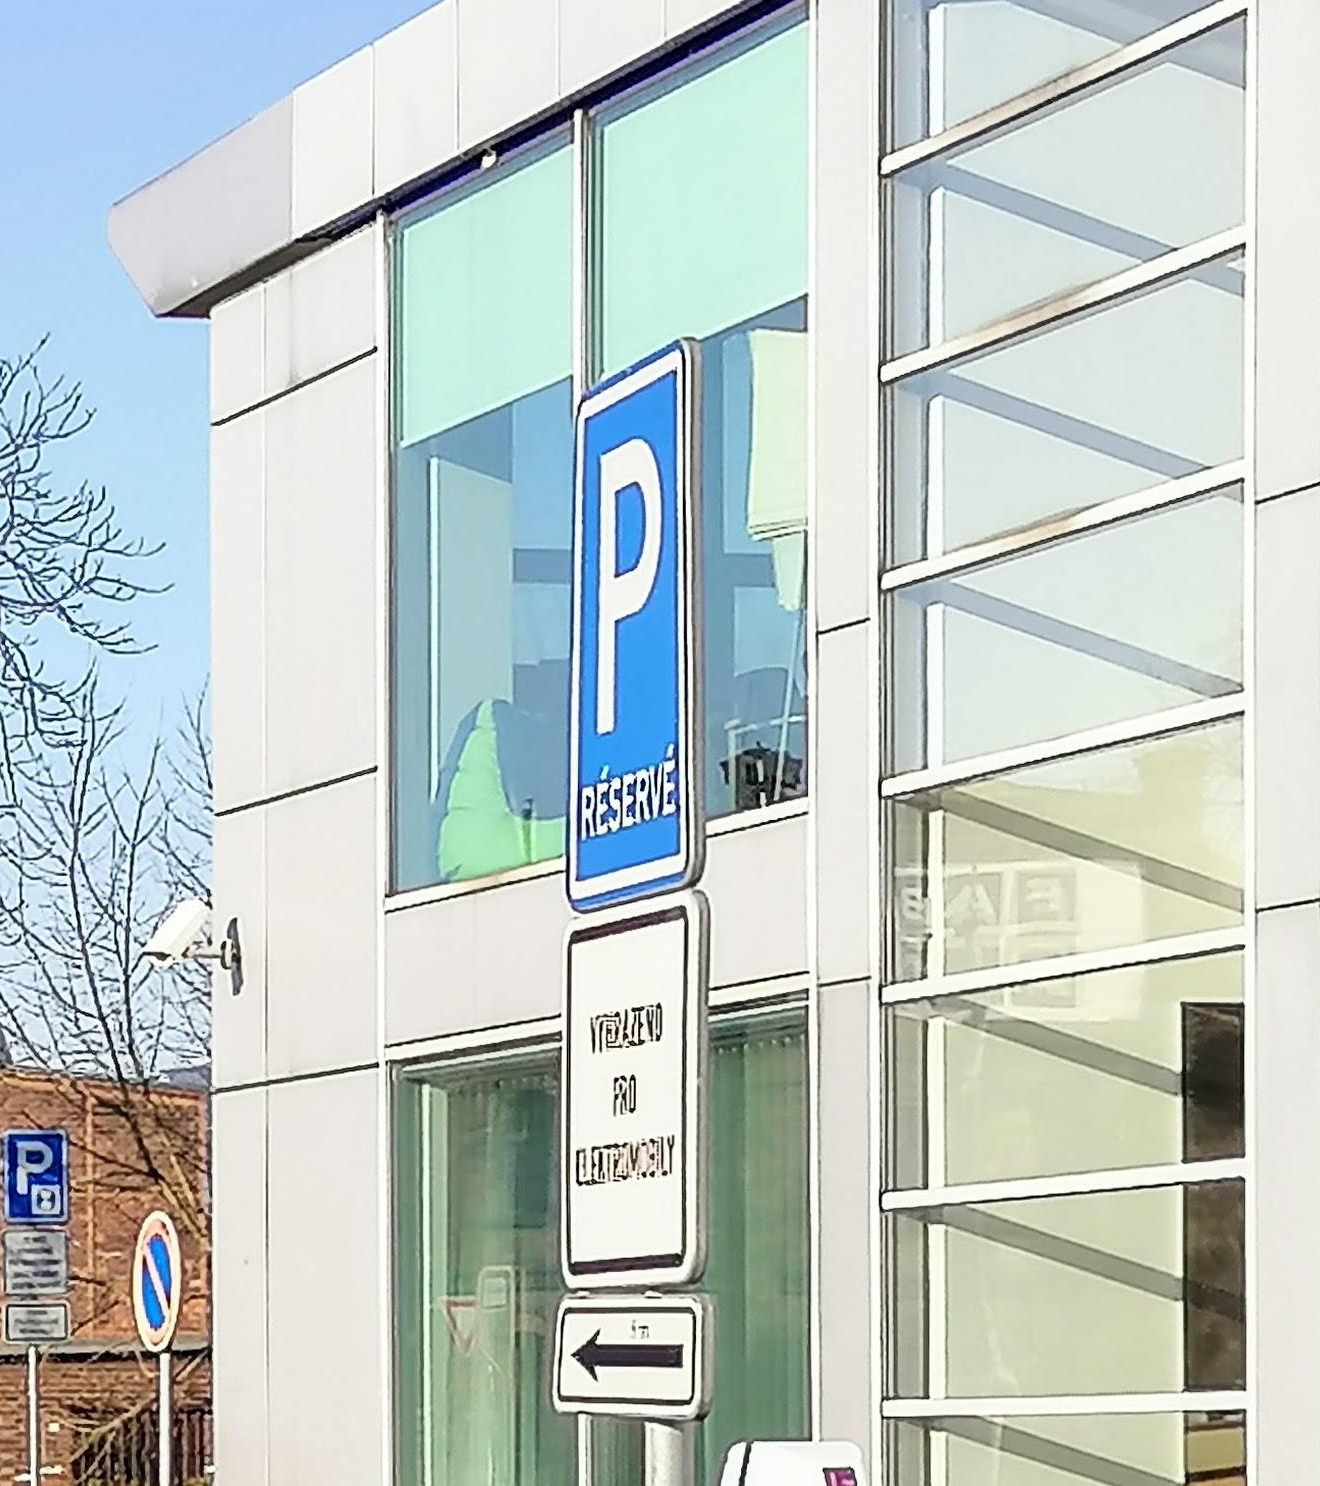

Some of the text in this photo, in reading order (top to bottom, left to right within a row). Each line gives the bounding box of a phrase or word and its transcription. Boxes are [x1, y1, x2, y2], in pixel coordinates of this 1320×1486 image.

[596, 437, 663, 735] P
[581, 743, 676, 842] RÉSERVÉ
[613, 1074, 636, 1117] PRO
[16, 1141, 53, 1195] P
